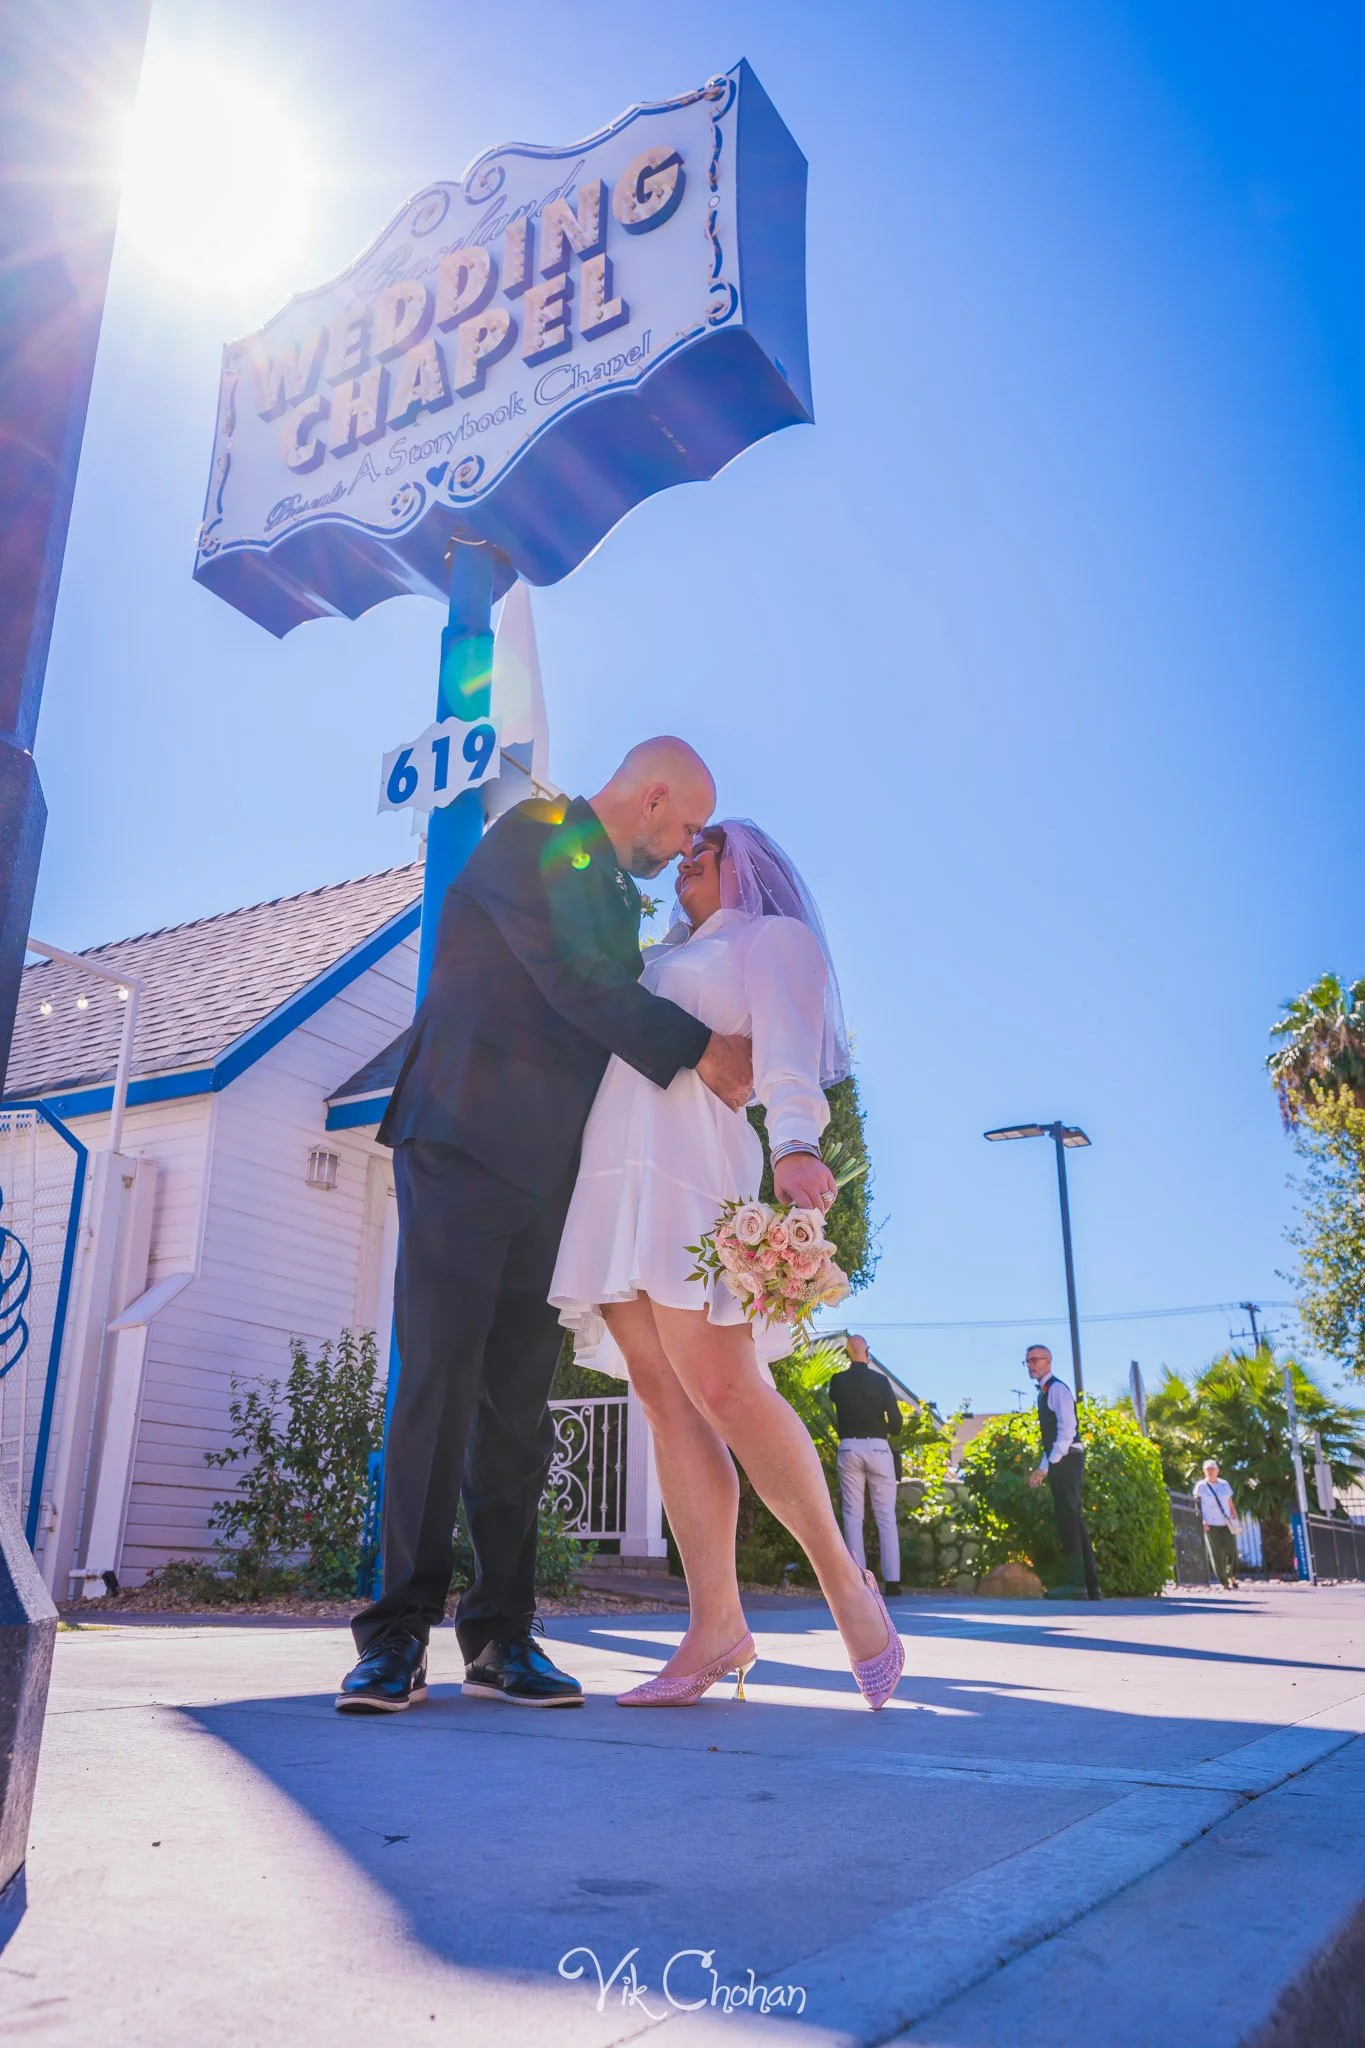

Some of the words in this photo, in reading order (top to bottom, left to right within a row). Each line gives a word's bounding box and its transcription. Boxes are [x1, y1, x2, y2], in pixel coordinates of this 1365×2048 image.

[250, 145, 687, 423] WEDDING
[278, 252, 630, 475] CHAPEL
[347, 452, 381, 496] A
[385, 390, 528, 476] Storybook
[534, 329, 652, 406] Chapel
[386, 723, 497, 804] 619
